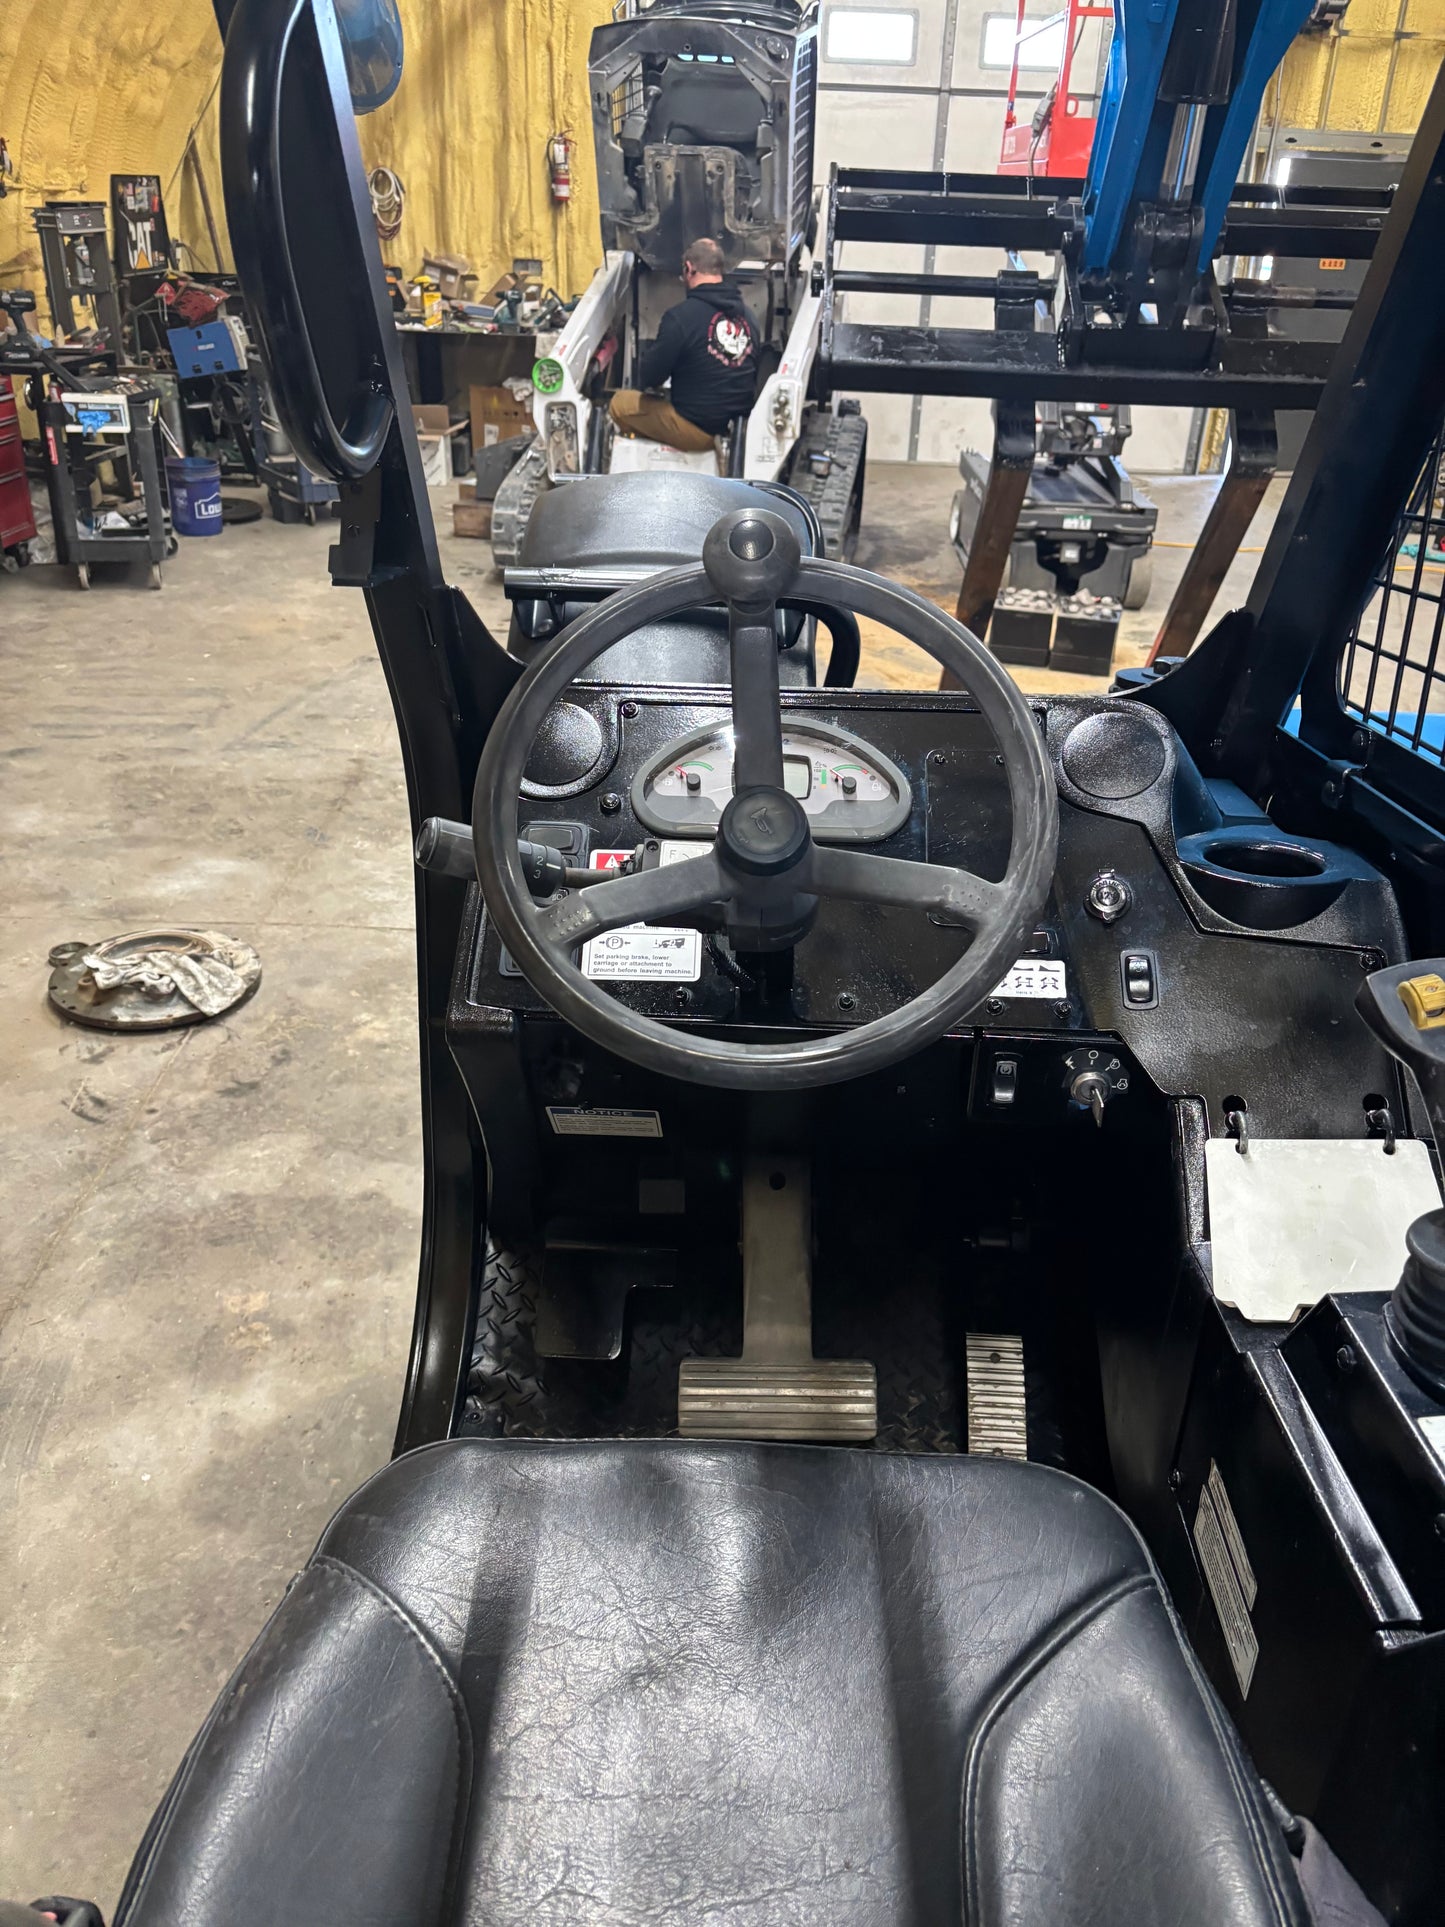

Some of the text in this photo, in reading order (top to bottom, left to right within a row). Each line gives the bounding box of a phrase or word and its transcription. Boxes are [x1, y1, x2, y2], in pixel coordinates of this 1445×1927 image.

[536, 855, 544, 866] 2
[533, 869, 542, 879] 3
[573, 1109, 633, 1117] NOTICE
